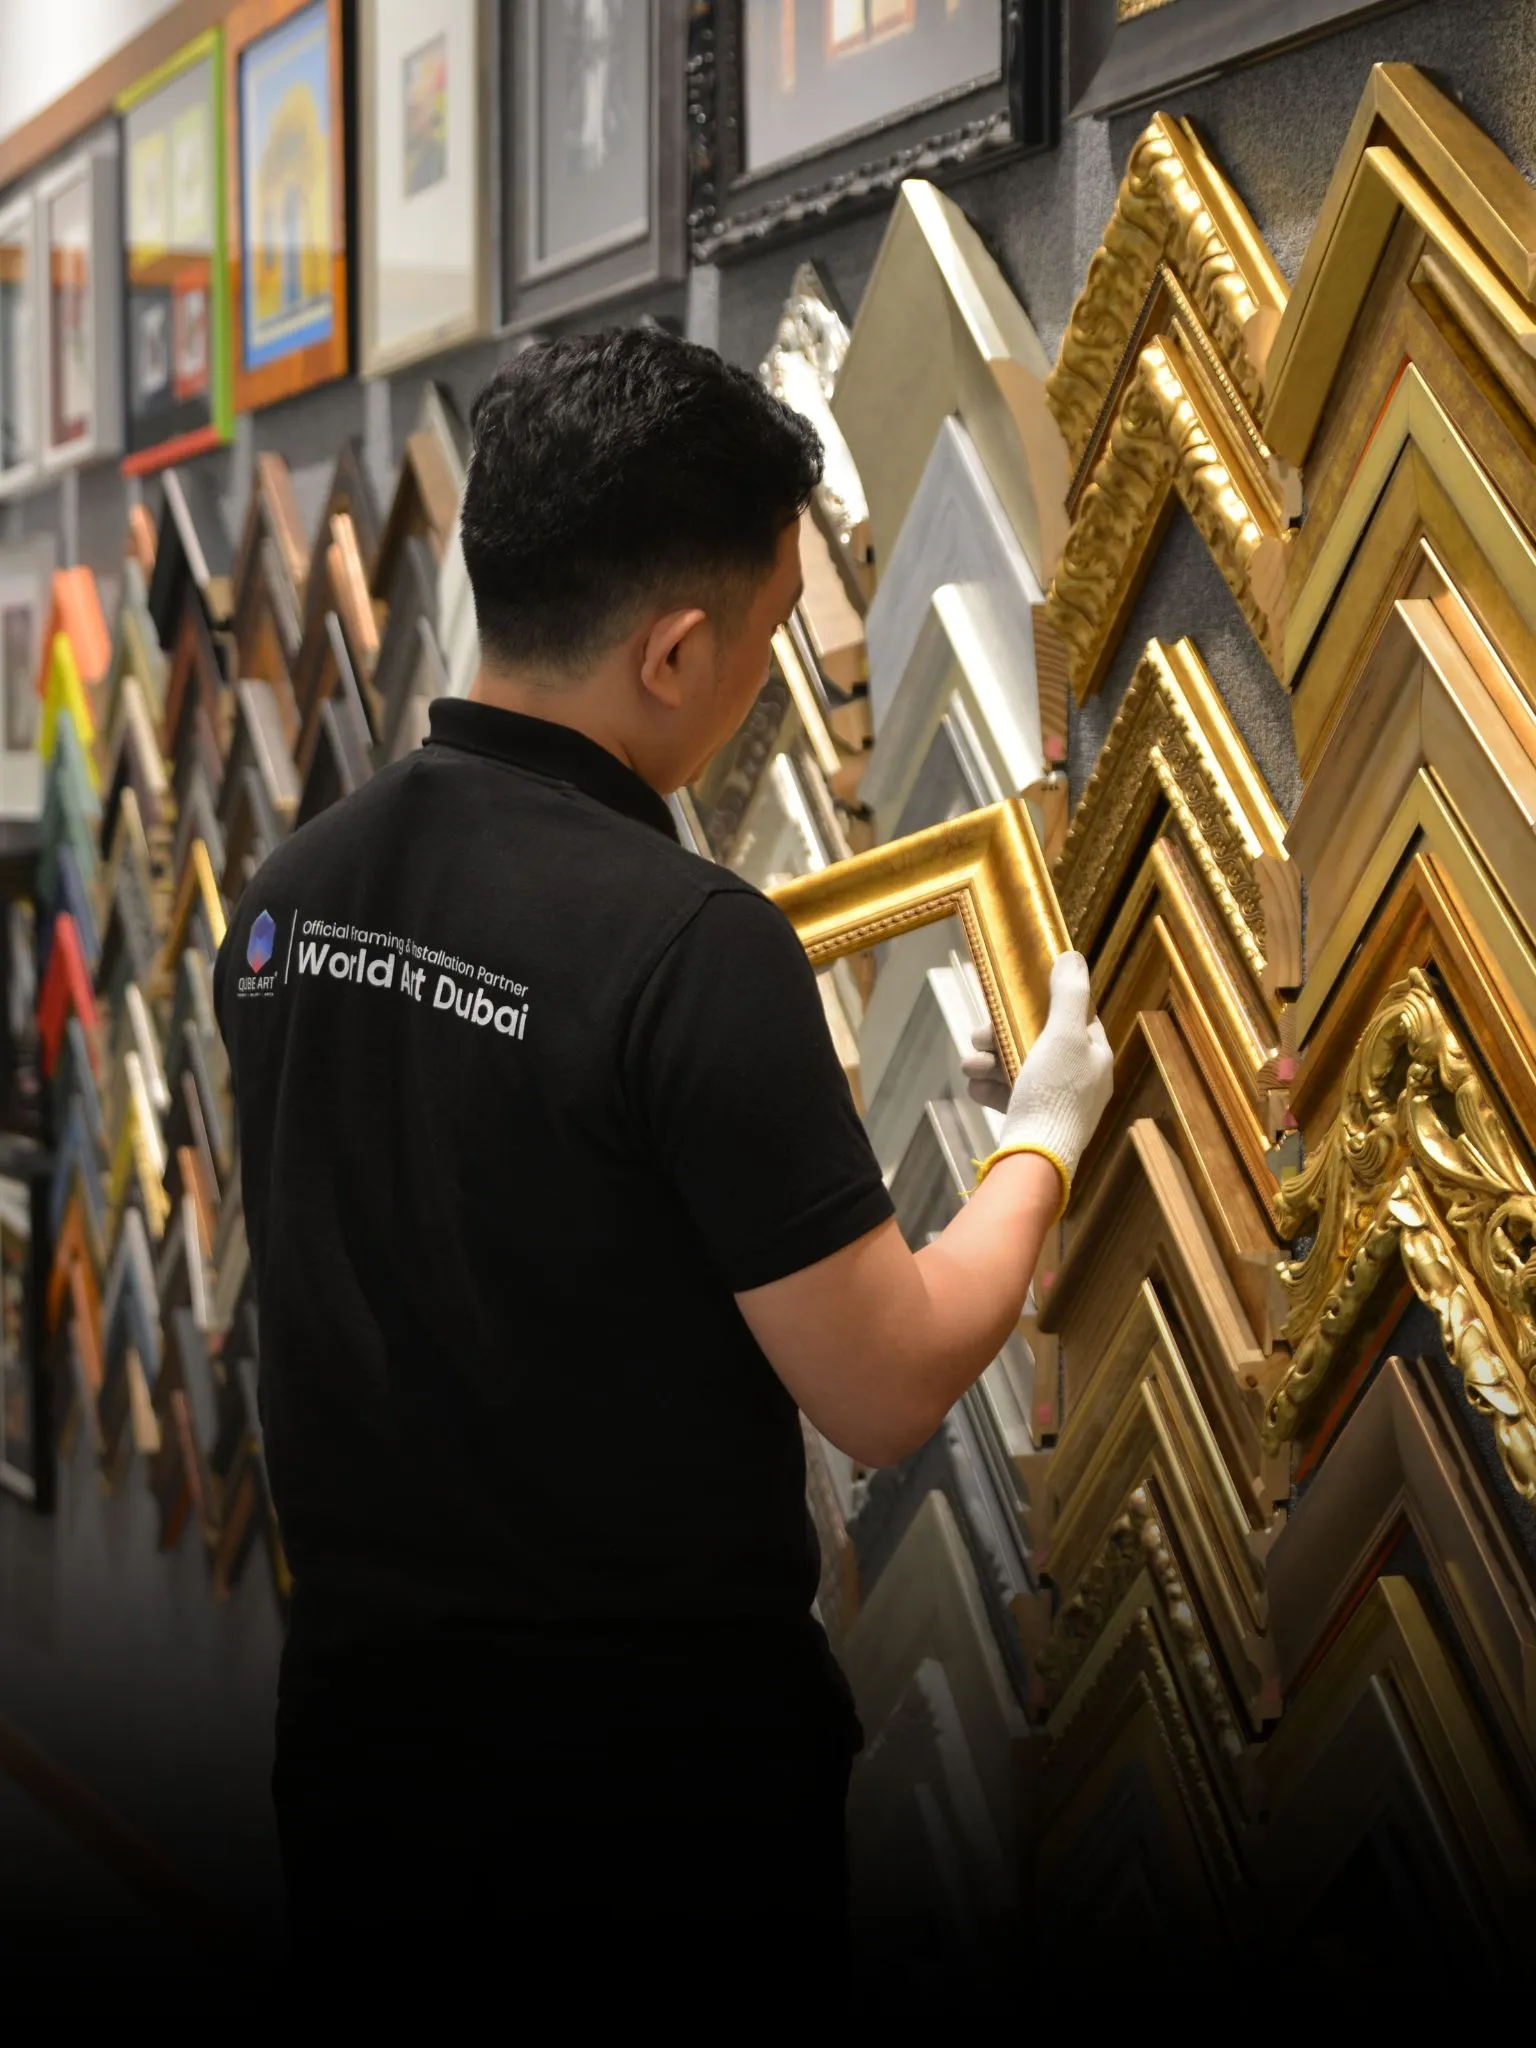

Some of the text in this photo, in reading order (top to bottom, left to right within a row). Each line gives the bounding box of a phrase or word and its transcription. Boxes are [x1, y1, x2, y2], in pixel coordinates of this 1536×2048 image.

[256, 976, 274, 989] ART
[298, 941, 529, 1040] World Art Dubai
[302, 920, 350, 939] Official
[350, 925, 405, 955] Framing
[477, 965, 529, 998] Partner
